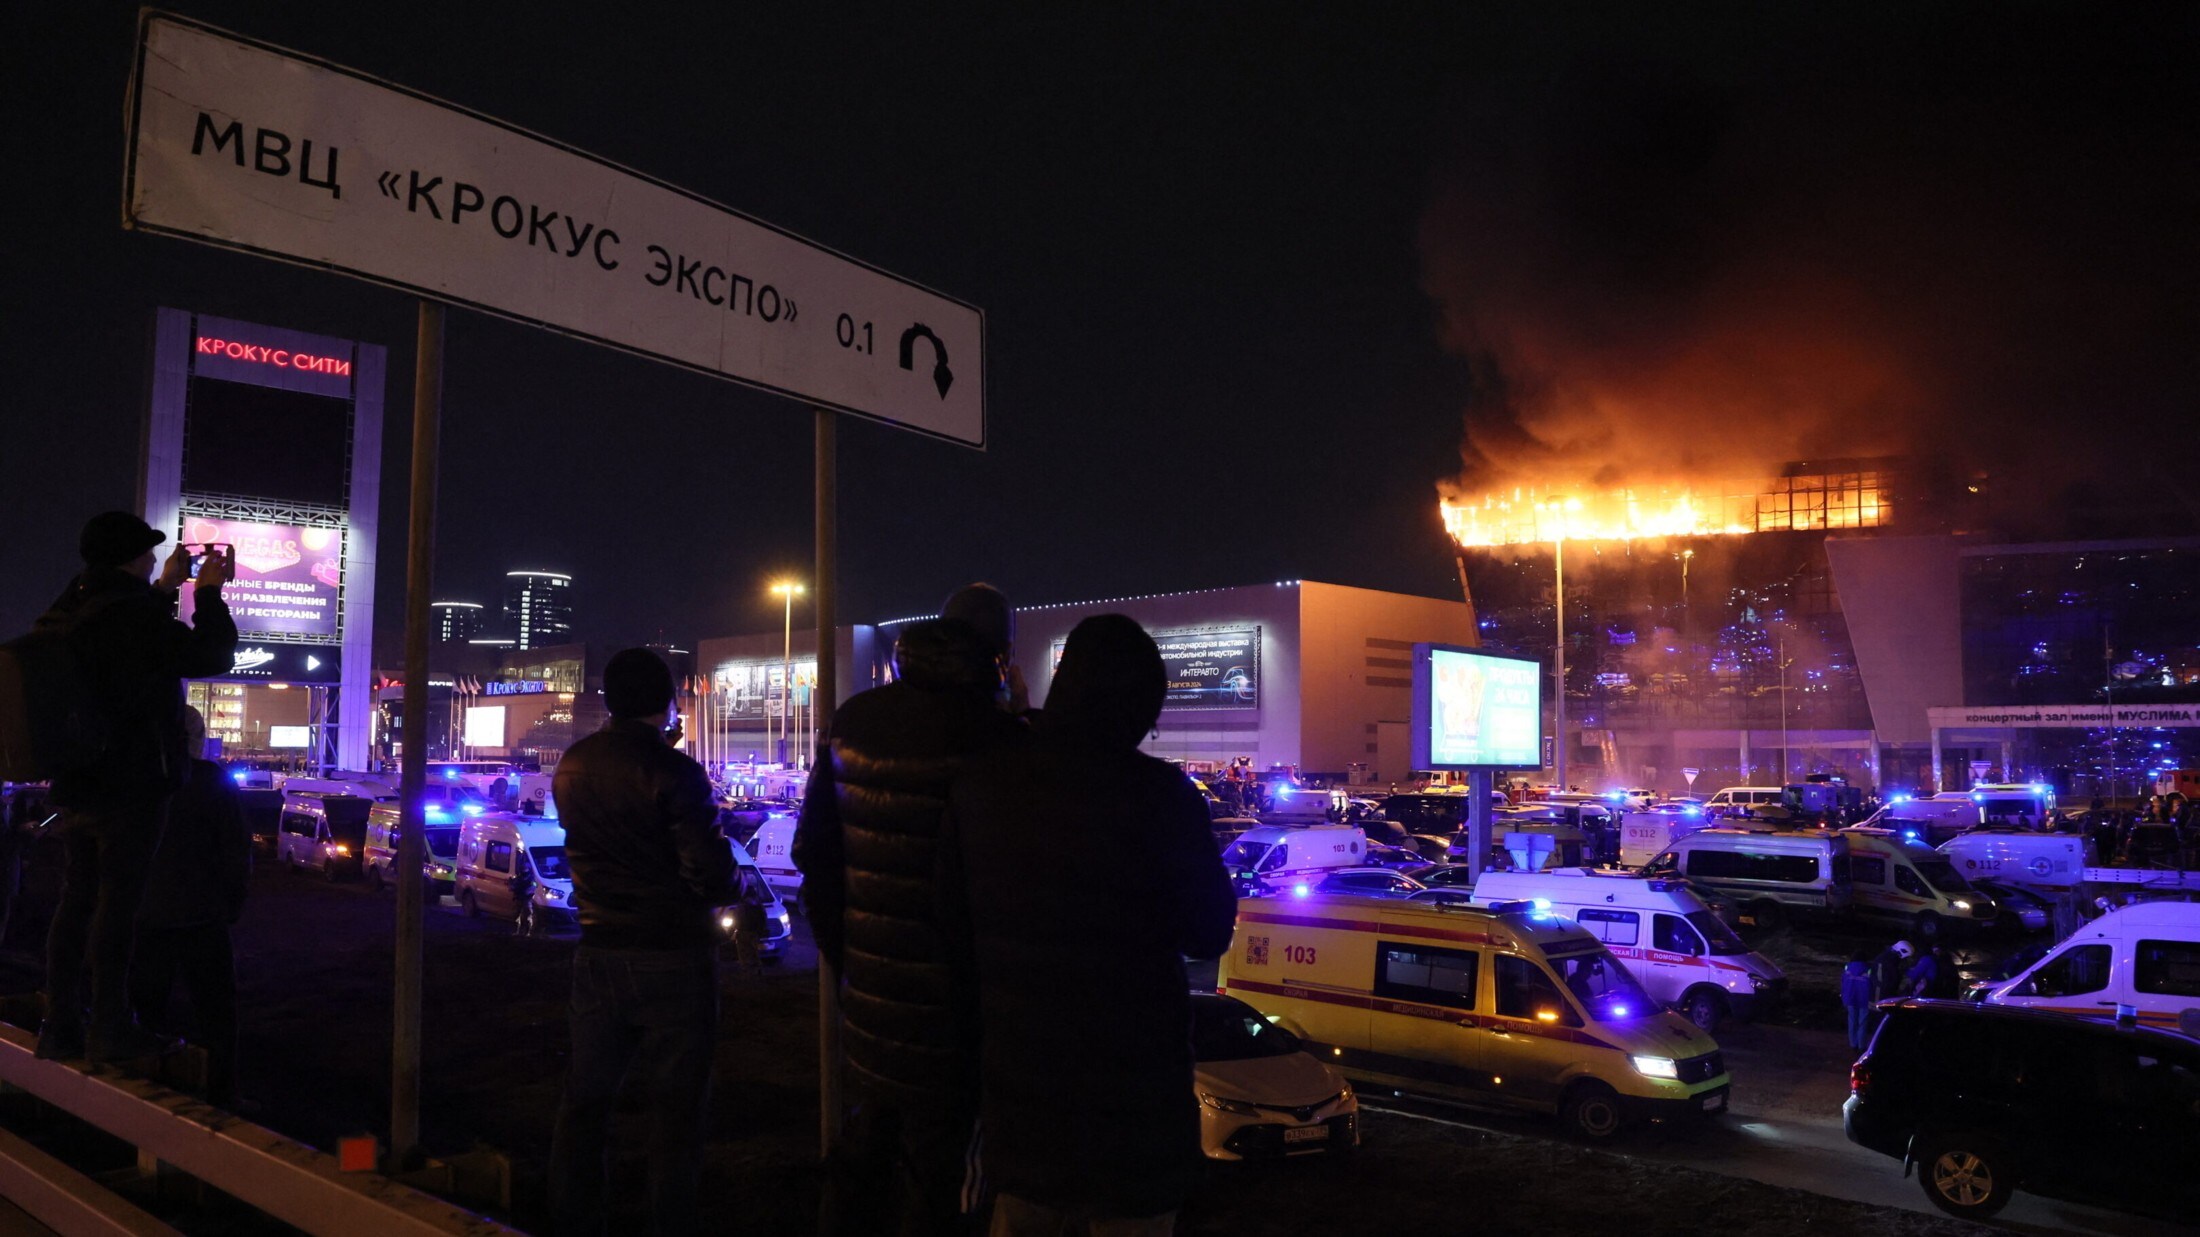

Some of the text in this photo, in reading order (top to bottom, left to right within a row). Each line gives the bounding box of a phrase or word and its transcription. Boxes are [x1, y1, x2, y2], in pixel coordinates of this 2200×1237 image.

[191, 112, 874, 355] МВЦ «КРОКУС ЭКСПО» 0.1
[198, 336, 350, 376] КРОКУС СИТИ
[230, 536, 298, 560] VEGAS
[223, 578, 315, 593] ДНЫЕ БРЕНДЫ
[231, 593, 240, 601] И
[243, 594, 327, 606] РАЗВЛЕЧЕНИЯ
[236, 607, 245, 616] И
[247, 608, 321, 620] РЕСТОРАНЫ
[1166, 641, 1217, 651] международная
[1218, 639, 1249, 647] выставка
[1208, 650, 1243, 658] индустрии
[1180, 667, 1219, 677] ИНТЕРАВТО
[1966, 712, 2042, 724] концертный
[2045, 713, 2067, 722] зал
[2071, 712, 2113, 721] имени
[2117, 711, 2192, 721] МУСЛИМА
[1639, 829, 1656, 838] 112
[772, 844, 784, 855] 112
[1333, 844, 1346, 853] 103
[1979, 860, 2001, 870] 112
[1284, 944, 1316, 965] 103
[1653, 953, 1685, 962] ПОМОЩЬ
